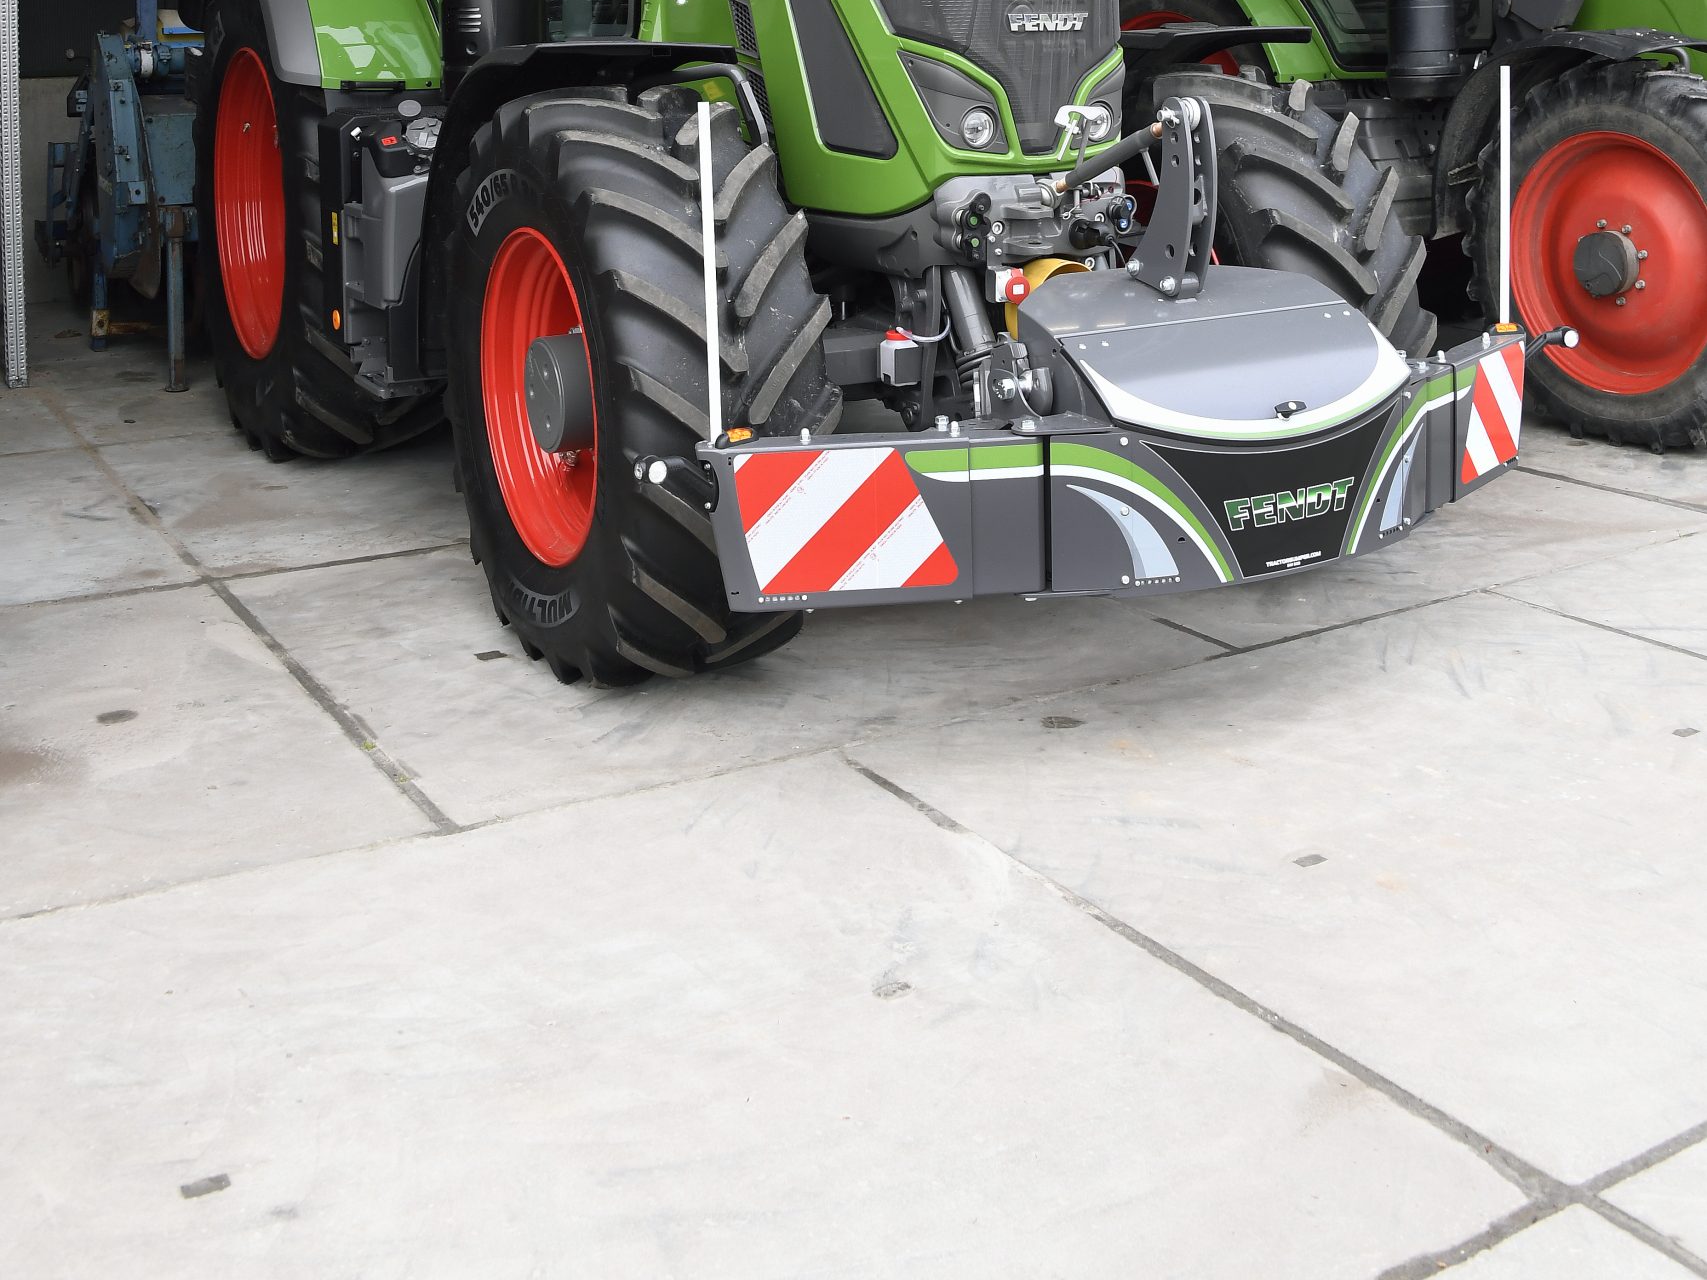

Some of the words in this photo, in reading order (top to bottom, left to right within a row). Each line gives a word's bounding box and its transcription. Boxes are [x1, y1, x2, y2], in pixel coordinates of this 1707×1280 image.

[1007, 12, 1089, 32] FENDT
[469, 173, 509, 229] 540/65
[1223, 476, 1355, 531] FENDT
